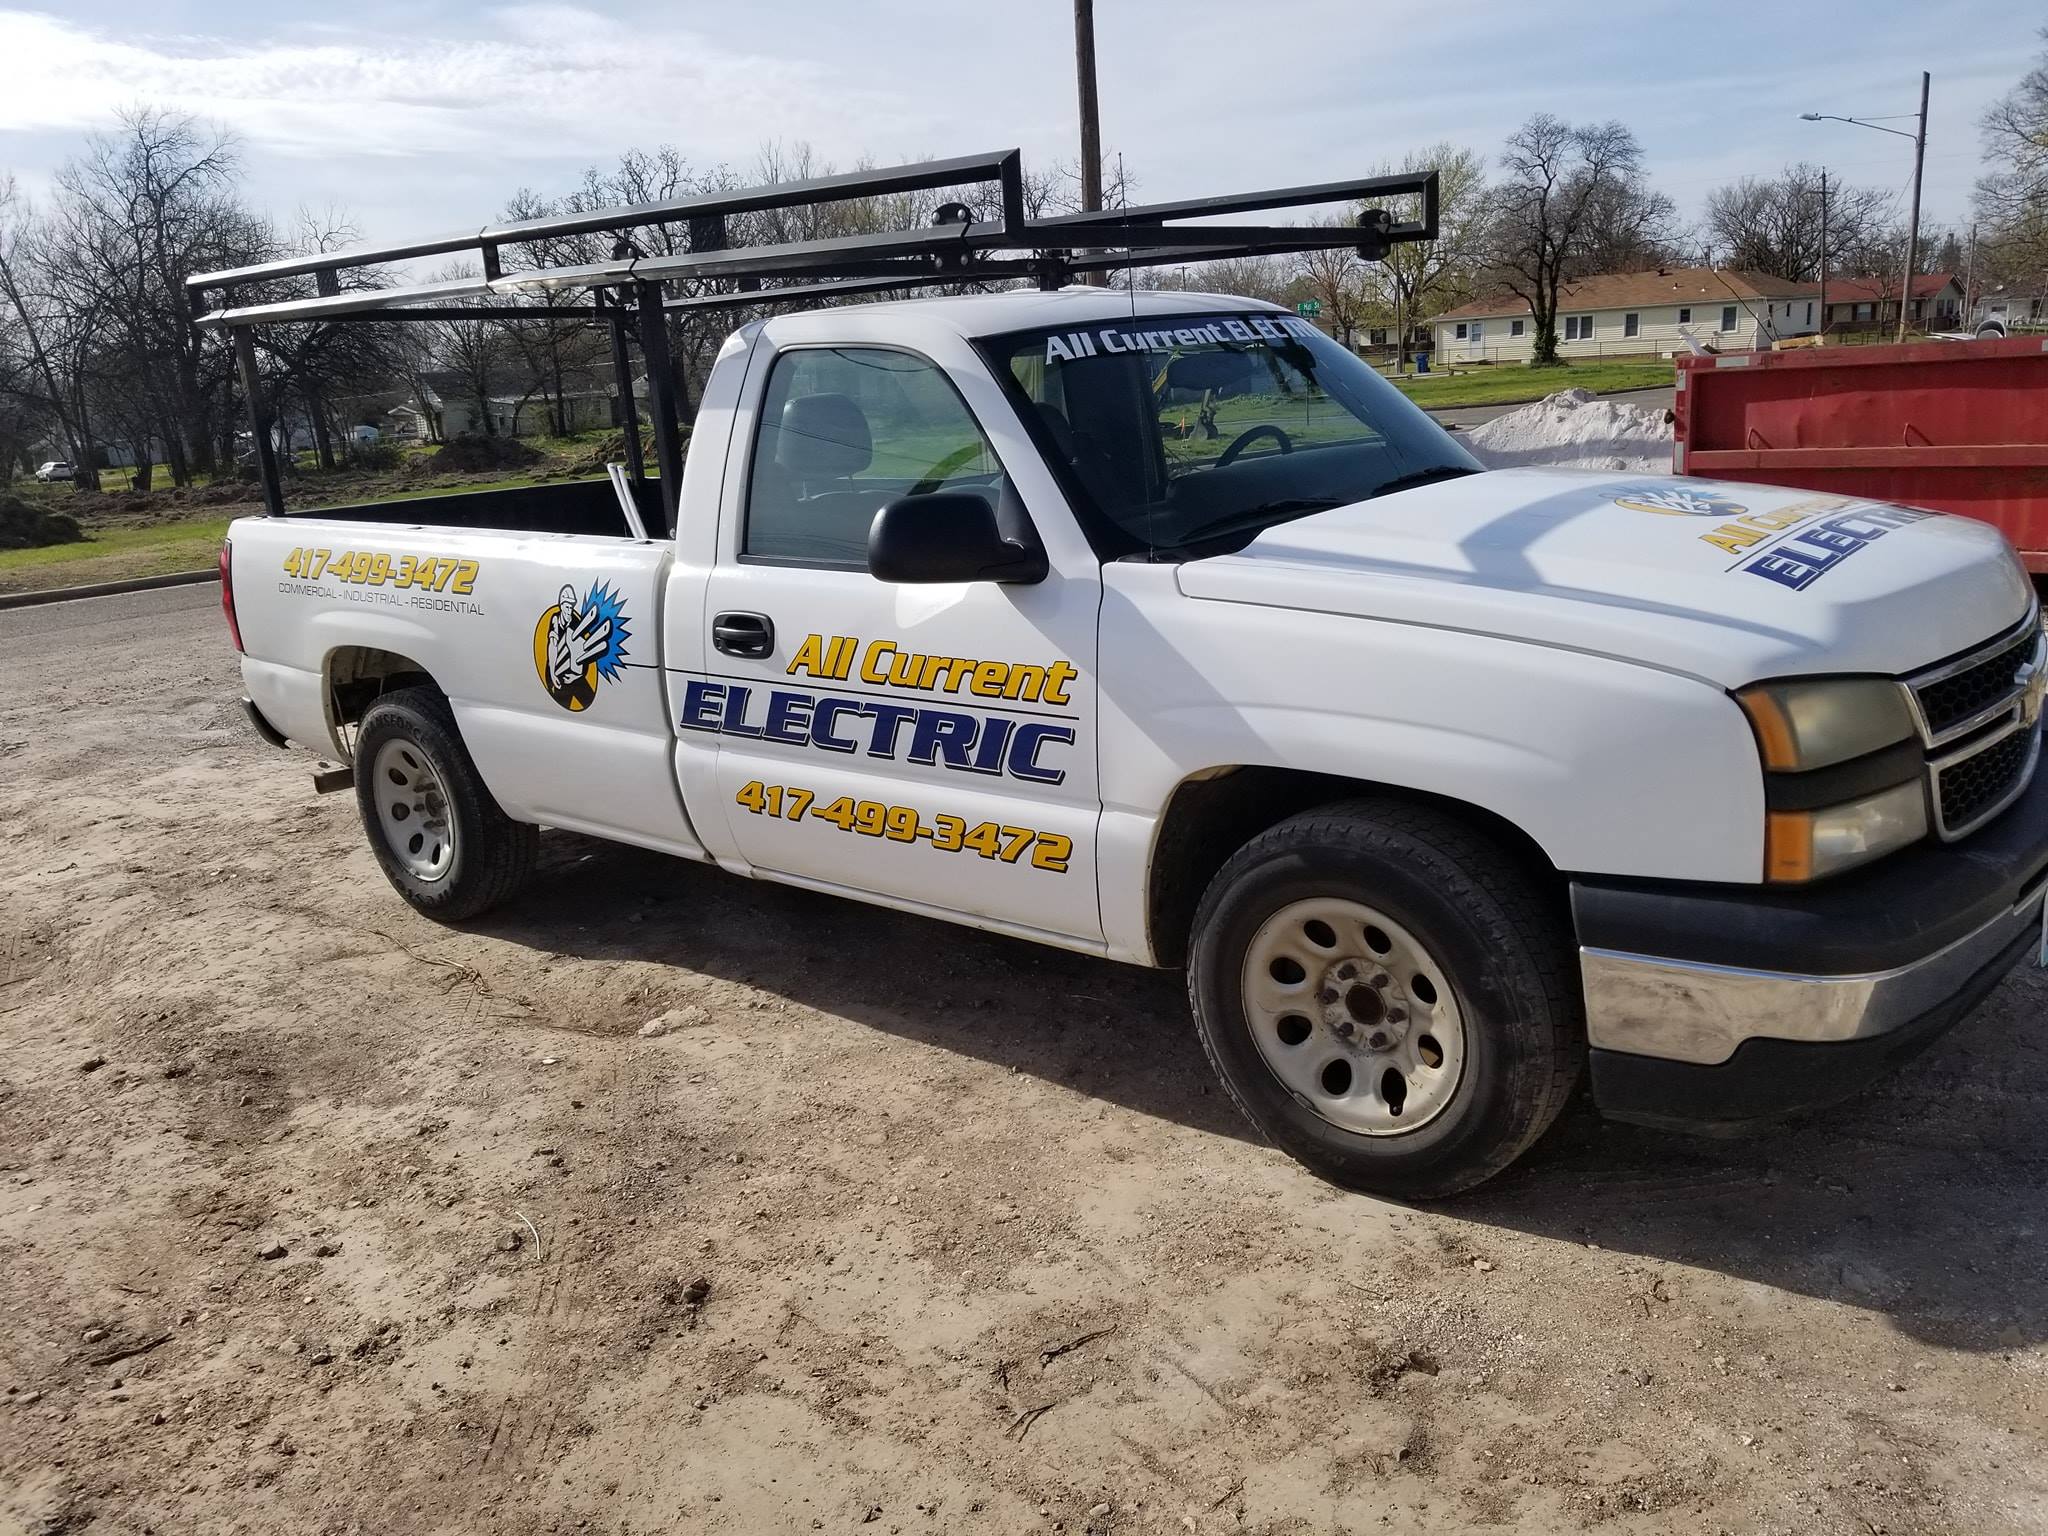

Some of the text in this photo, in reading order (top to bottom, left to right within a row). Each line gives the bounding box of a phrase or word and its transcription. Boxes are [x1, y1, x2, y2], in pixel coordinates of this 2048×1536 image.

[1045, 331, 1097, 365] All
[1101, 323, 1230, 353] Current
[1698, 524, 1772, 555] All
[283, 547, 480, 595] 417-499-3472
[278, 582, 338, 599] COMMERCIAL
[343, 589, 403, 608] INDUSTRIAL
[410, 597, 485, 616] RESIDENTIAL
[786, 634, 1078, 704] All Current
[679, 679, 1078, 786] ELECTRIC
[735, 780, 1074, 873] 417-499-3472
